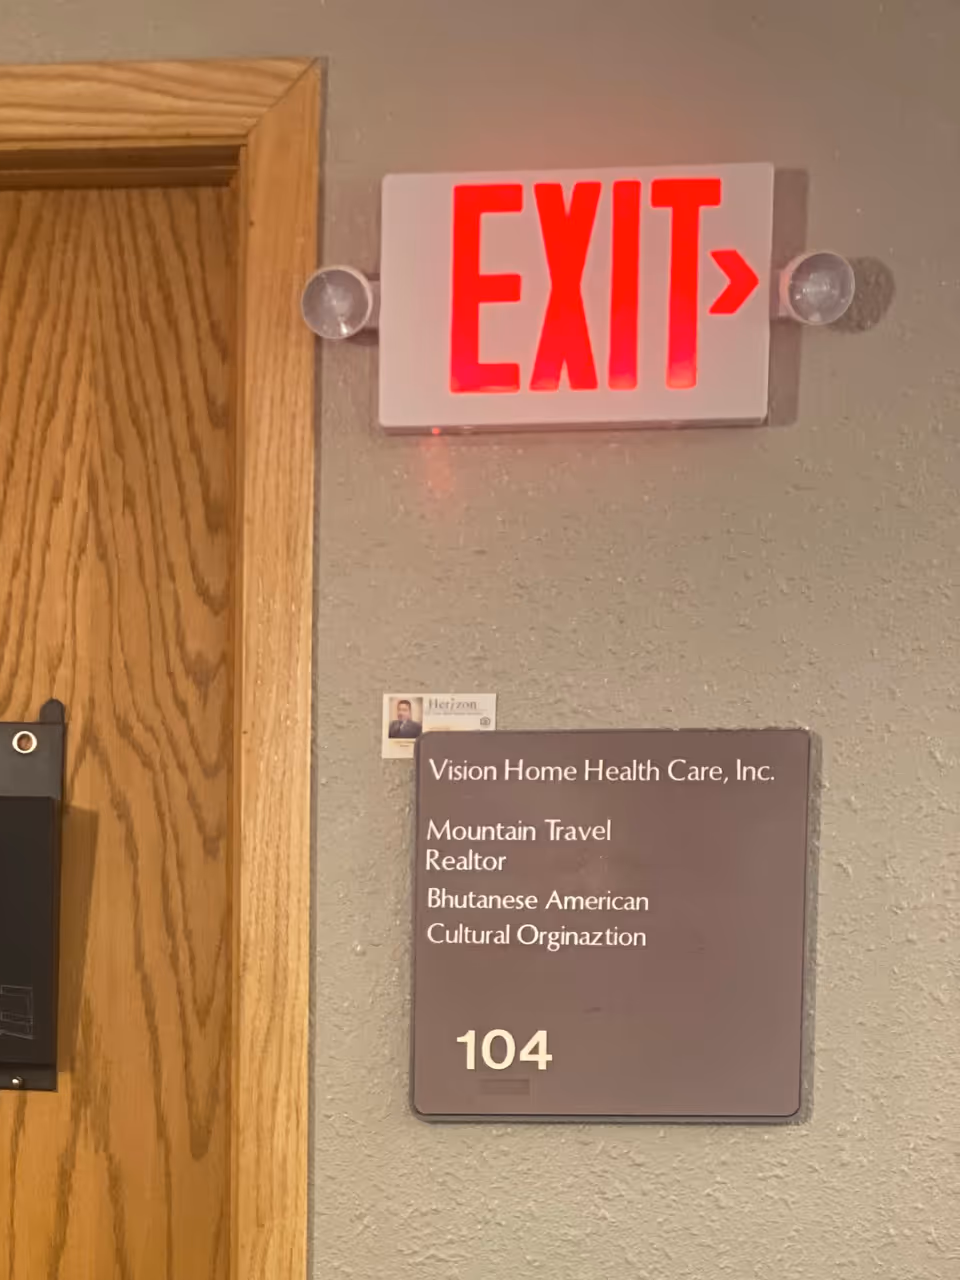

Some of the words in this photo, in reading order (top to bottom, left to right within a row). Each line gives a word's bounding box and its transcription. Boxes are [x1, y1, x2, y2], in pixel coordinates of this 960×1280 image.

[448, 178, 722, 394] EXIT
[428, 757, 498, 782] Vision
[504, 758, 578, 782] Home
[584, 758, 660, 782] Health
[667, 758, 729, 785] Care,
[736, 758, 776, 782] Inc.
[426, 818, 537, 841] Mountain
[543, 818, 612, 841] Travel
[425, 848, 507, 871] Realtor
[427, 887, 539, 910] Bhutanese
[544, 889, 649, 911] American
[426, 922, 511, 945] Cultural
[516, 923, 647, 952] Orginaztion
[456, 1028, 553, 1071] 104
